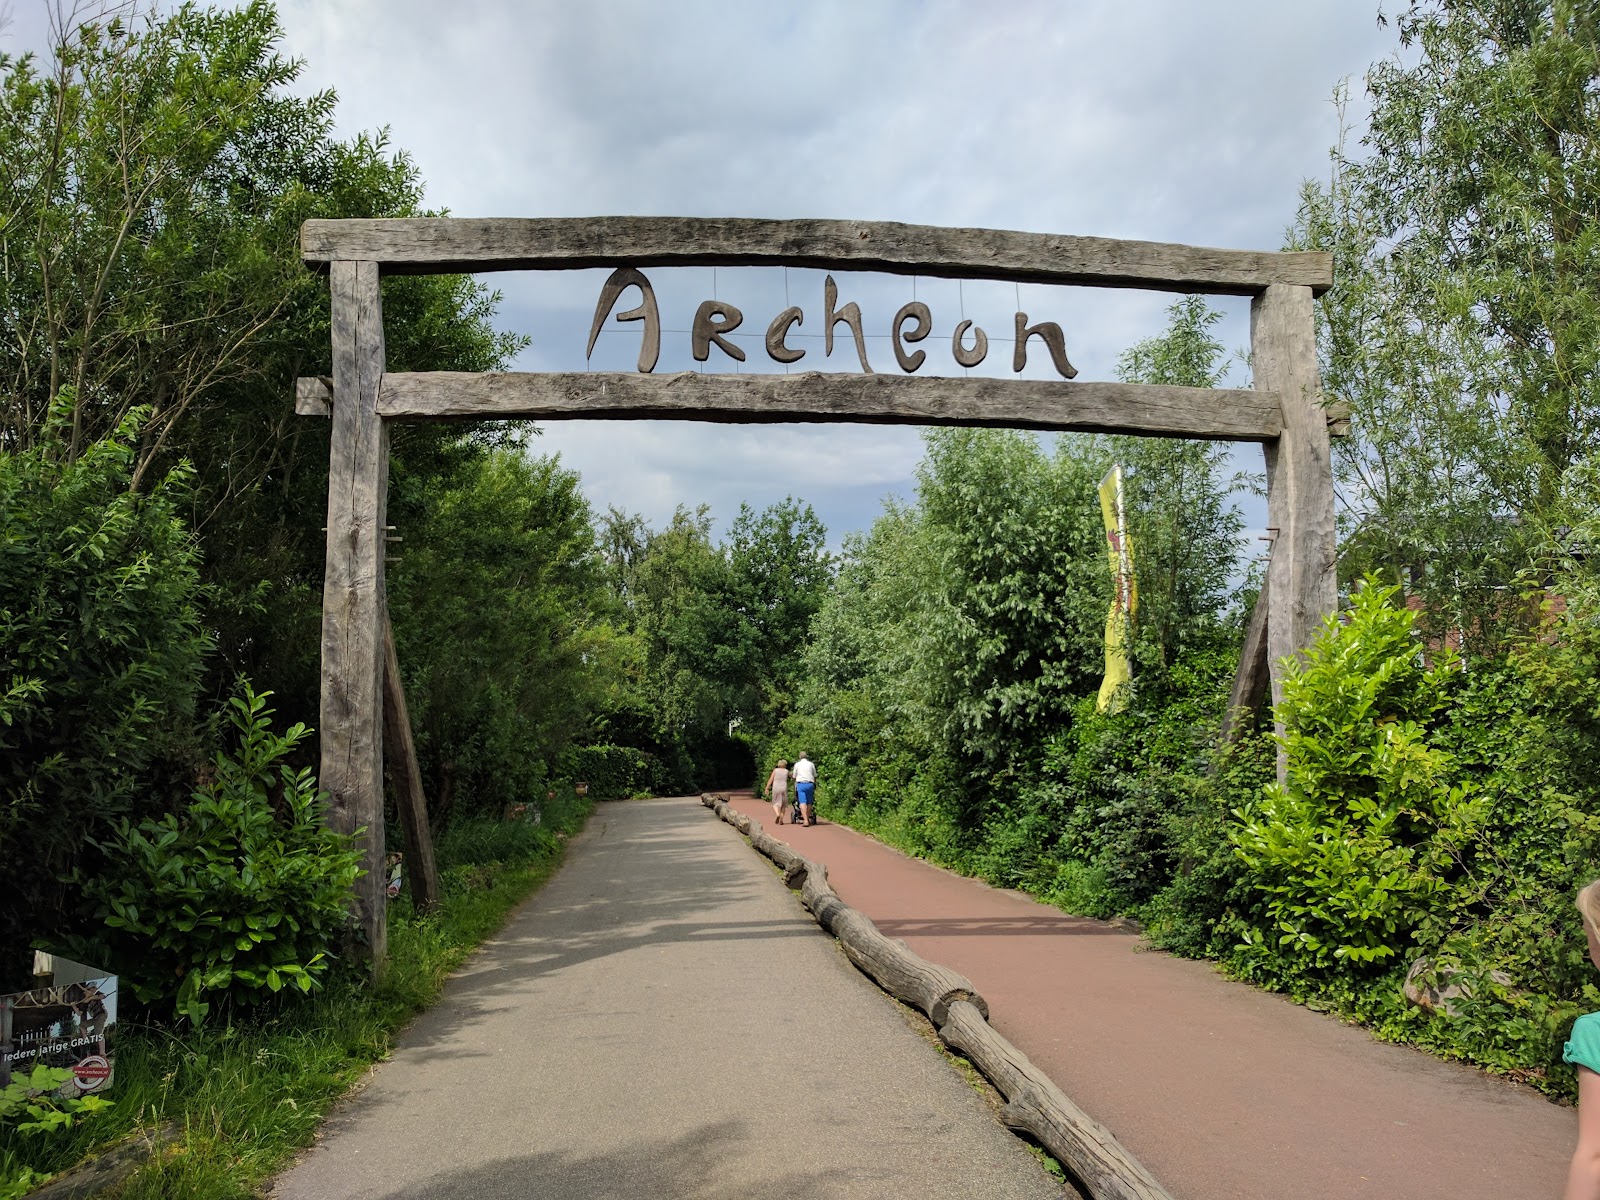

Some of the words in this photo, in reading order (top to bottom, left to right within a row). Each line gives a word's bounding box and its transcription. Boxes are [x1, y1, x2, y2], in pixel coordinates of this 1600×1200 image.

[4, 1049, 37, 1062] Iedere
[39, 1042, 68, 1056] jarige
[71, 1033, 105, 1048] GRATIS
